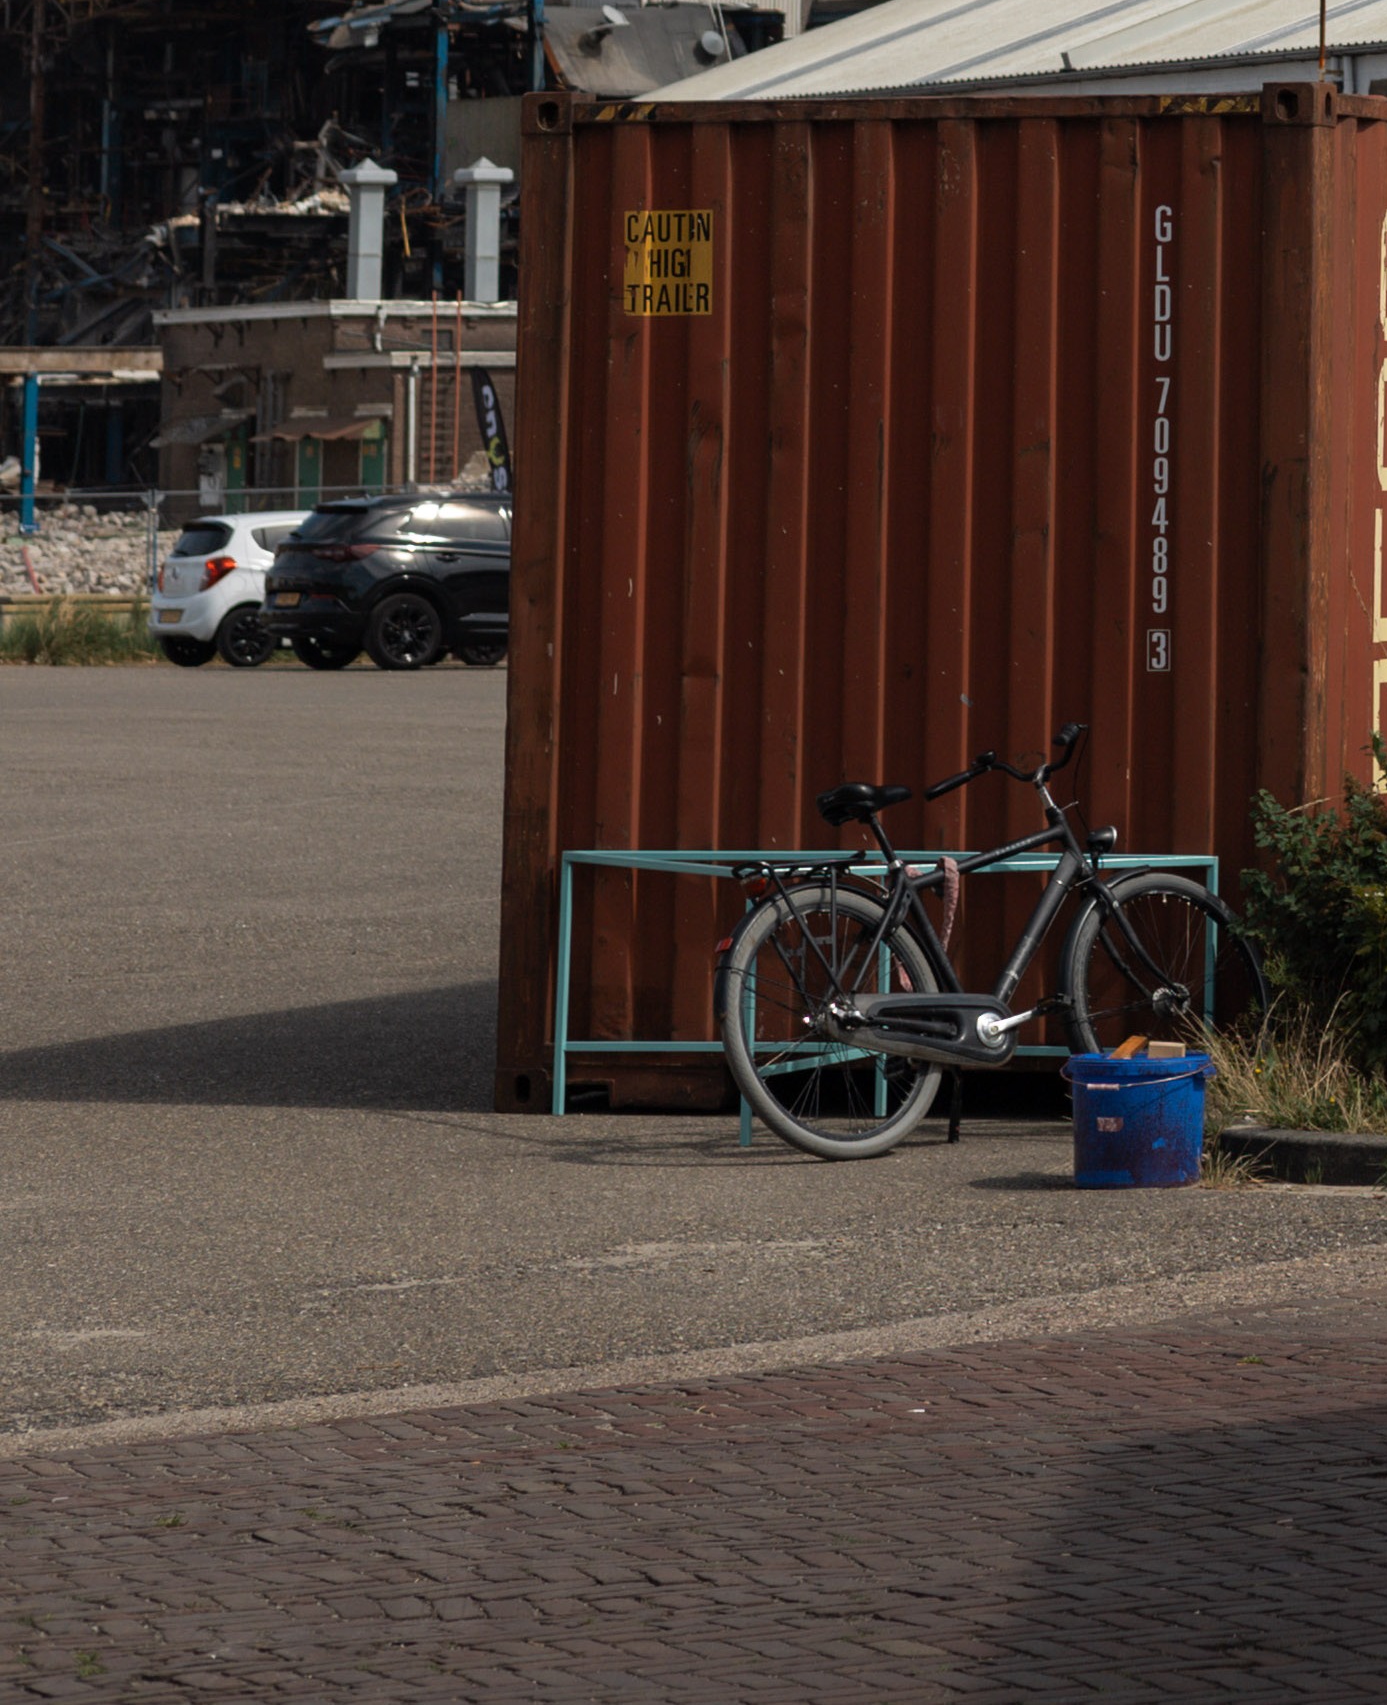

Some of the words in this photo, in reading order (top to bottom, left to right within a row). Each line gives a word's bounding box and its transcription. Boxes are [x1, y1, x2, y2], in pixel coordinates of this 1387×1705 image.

[1153, 204, 1173, 362] GLDU
[1151, 376, 1171, 614] 709489
[1150, 631, 1168, 670] 3
